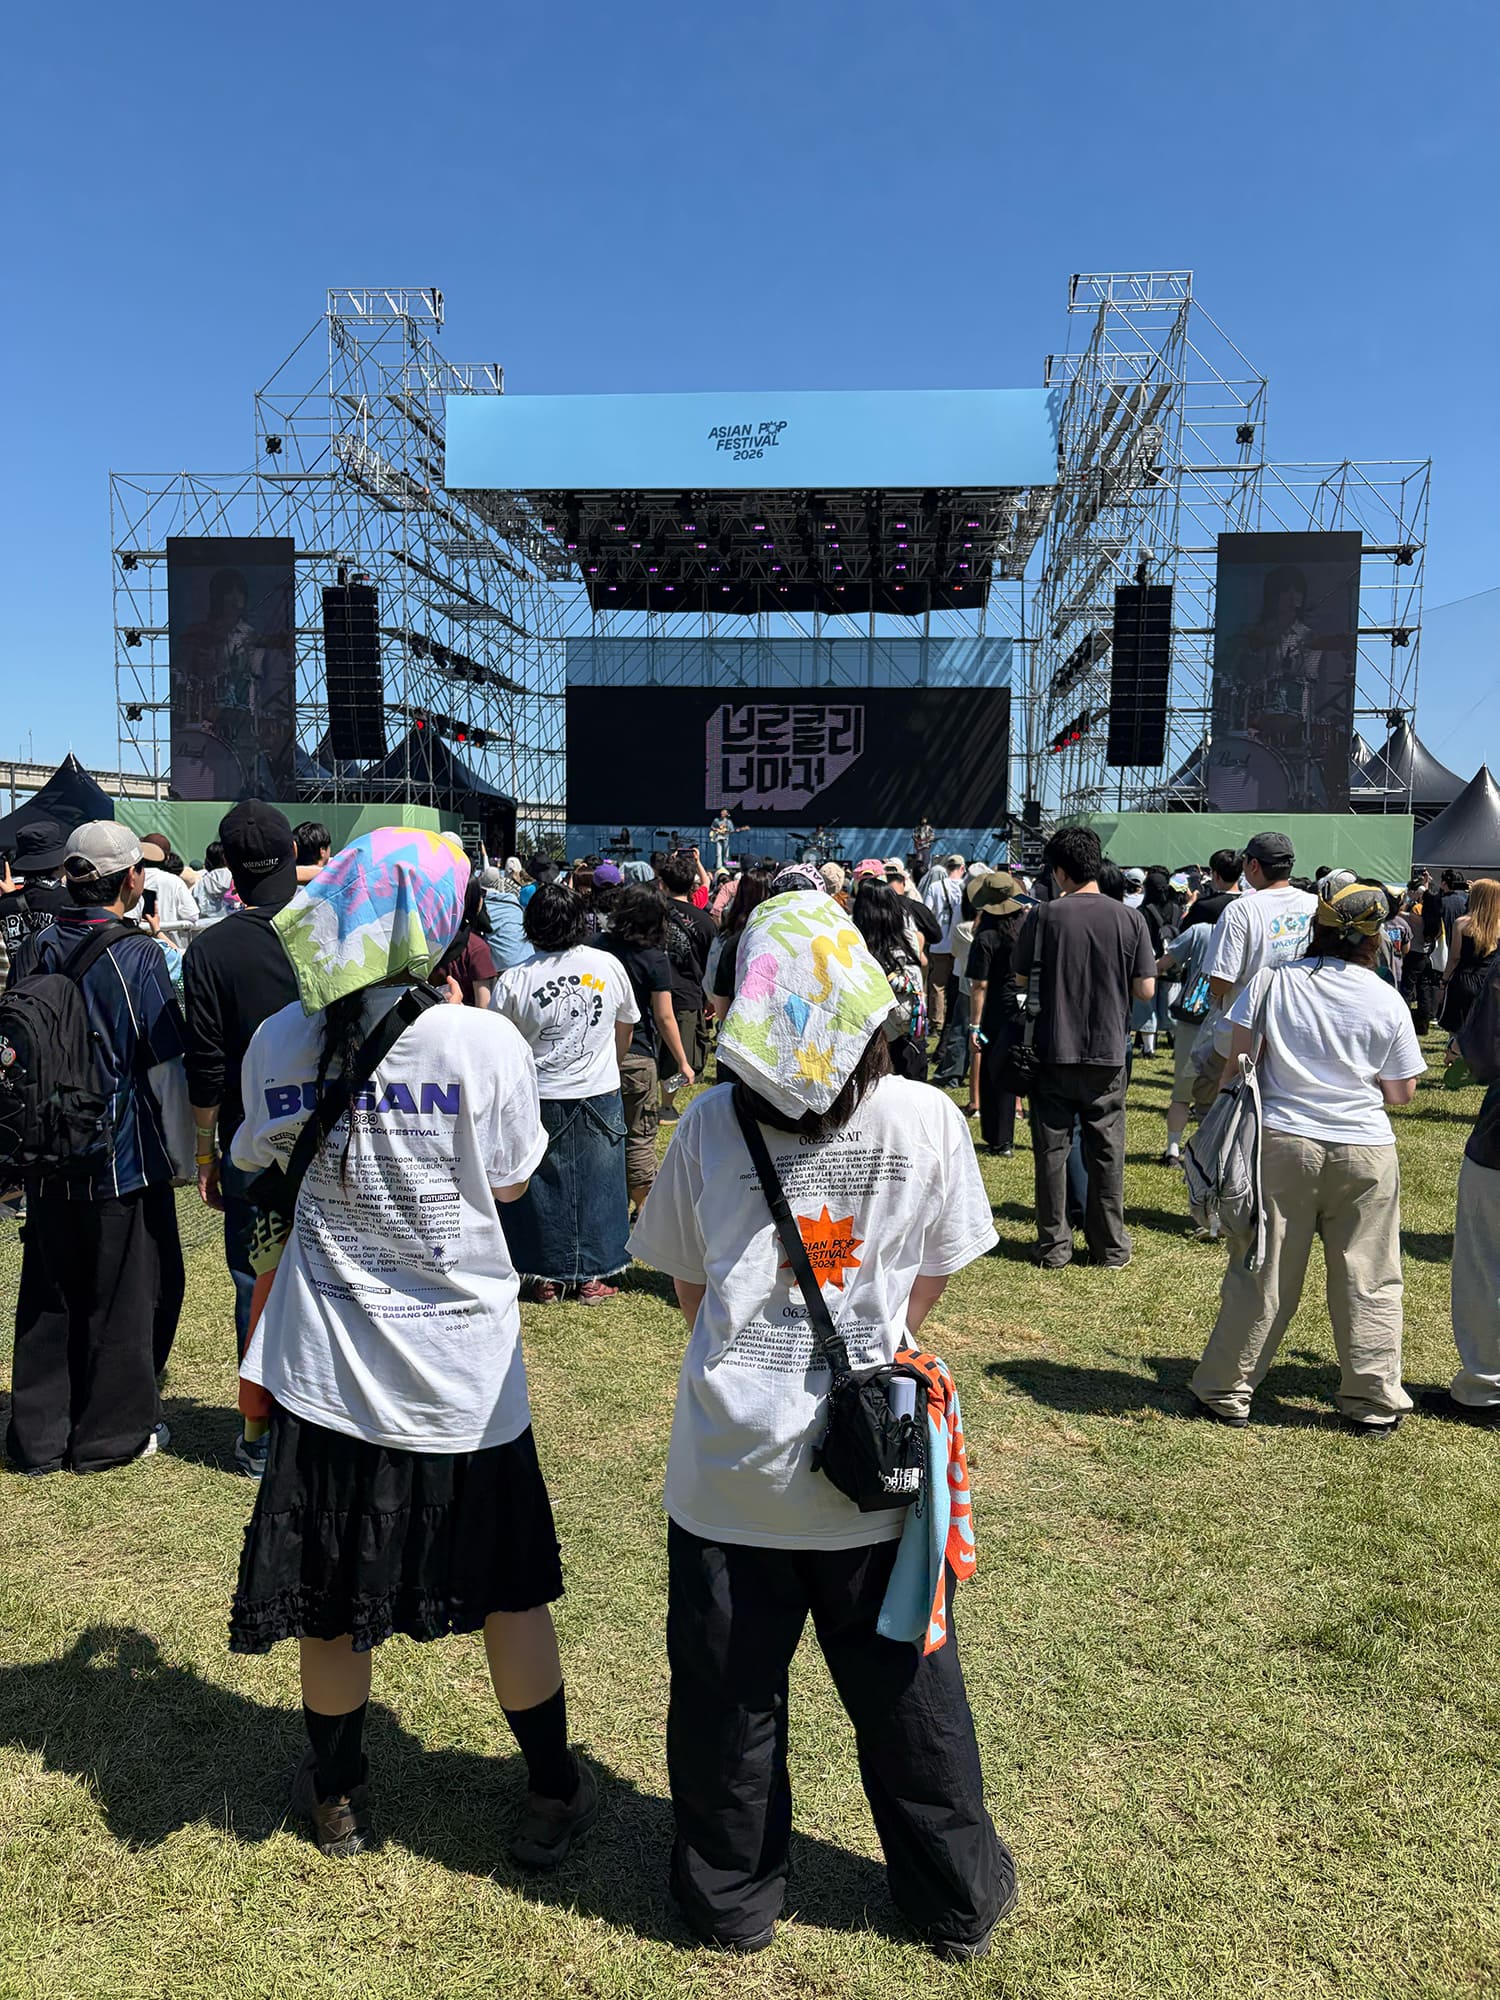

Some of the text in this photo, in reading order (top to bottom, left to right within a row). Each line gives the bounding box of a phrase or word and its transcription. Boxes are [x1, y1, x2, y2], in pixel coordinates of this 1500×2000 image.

[708, 420, 788, 440] ASIAN POP
[716, 434, 780, 451] FESTIVAL
[733, 449, 764, 461] 2026
[720, 757, 826, 794] 너마저
[362, 1128, 388, 1136] ROCK
[389, 1129, 440, 1137] FESTIVAL
[799, 1131, 863, 1146] 06.22 SAT
[356, 1193, 460, 1203] ANNE-MARIE SATURDAY
[832, 1239, 856, 1250] POP
[363, 1303, 406, 1312] OCTOBER
[439, 1308, 470, 1318] BUSAN
